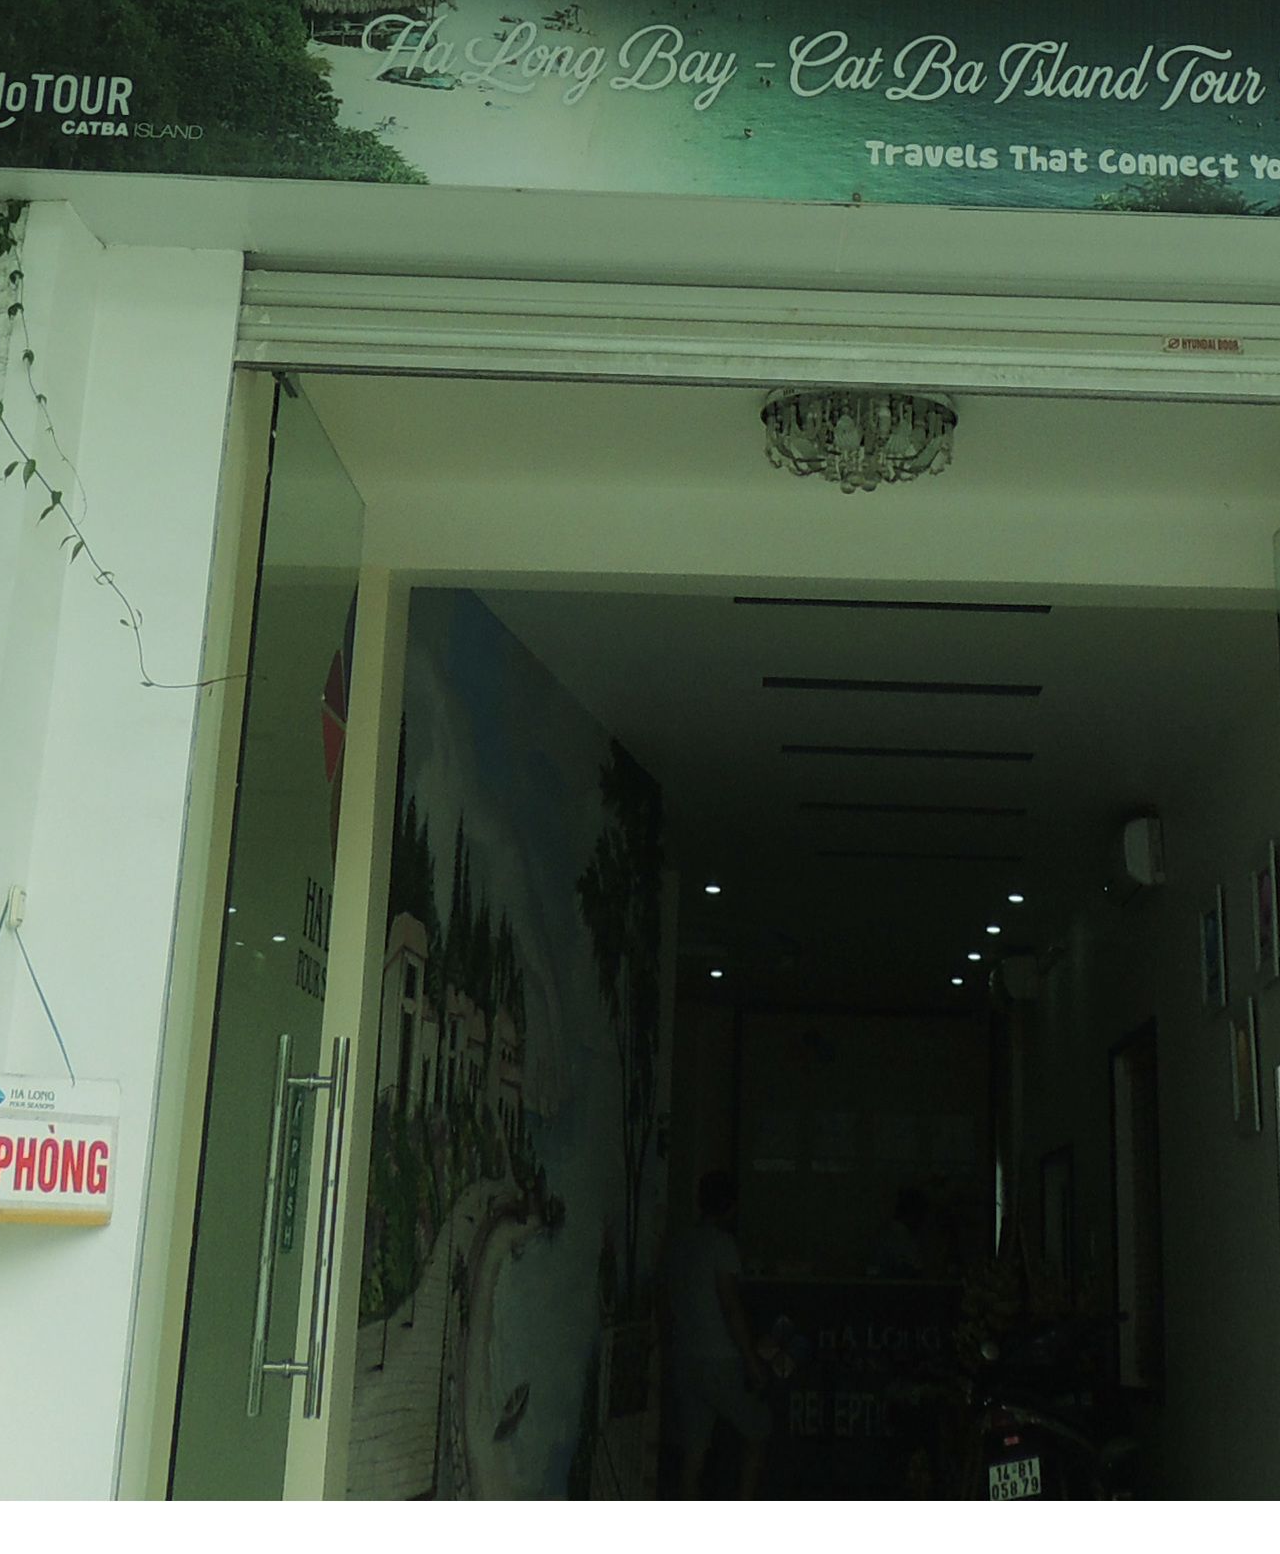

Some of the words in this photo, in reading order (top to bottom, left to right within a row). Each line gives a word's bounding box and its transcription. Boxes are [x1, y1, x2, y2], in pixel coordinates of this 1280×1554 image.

[361, 14, 459, 80] Ha
[460, 21, 608, 105] Long
[610, 24, 737, 111] Bay
[789, 30, 883, 98] Cat
[885, 35, 987, 101] Ba
[994, 40, 1149, 104] Island
[1156, 45, 1266, 111] Tour
[61, 120, 128, 137] CATBA
[134, 122, 204, 140] ISLAND
[865, 141, 998, 170] Travels
[1009, 146, 1088, 173] That
[1099, 148, 1239, 179] Connect
